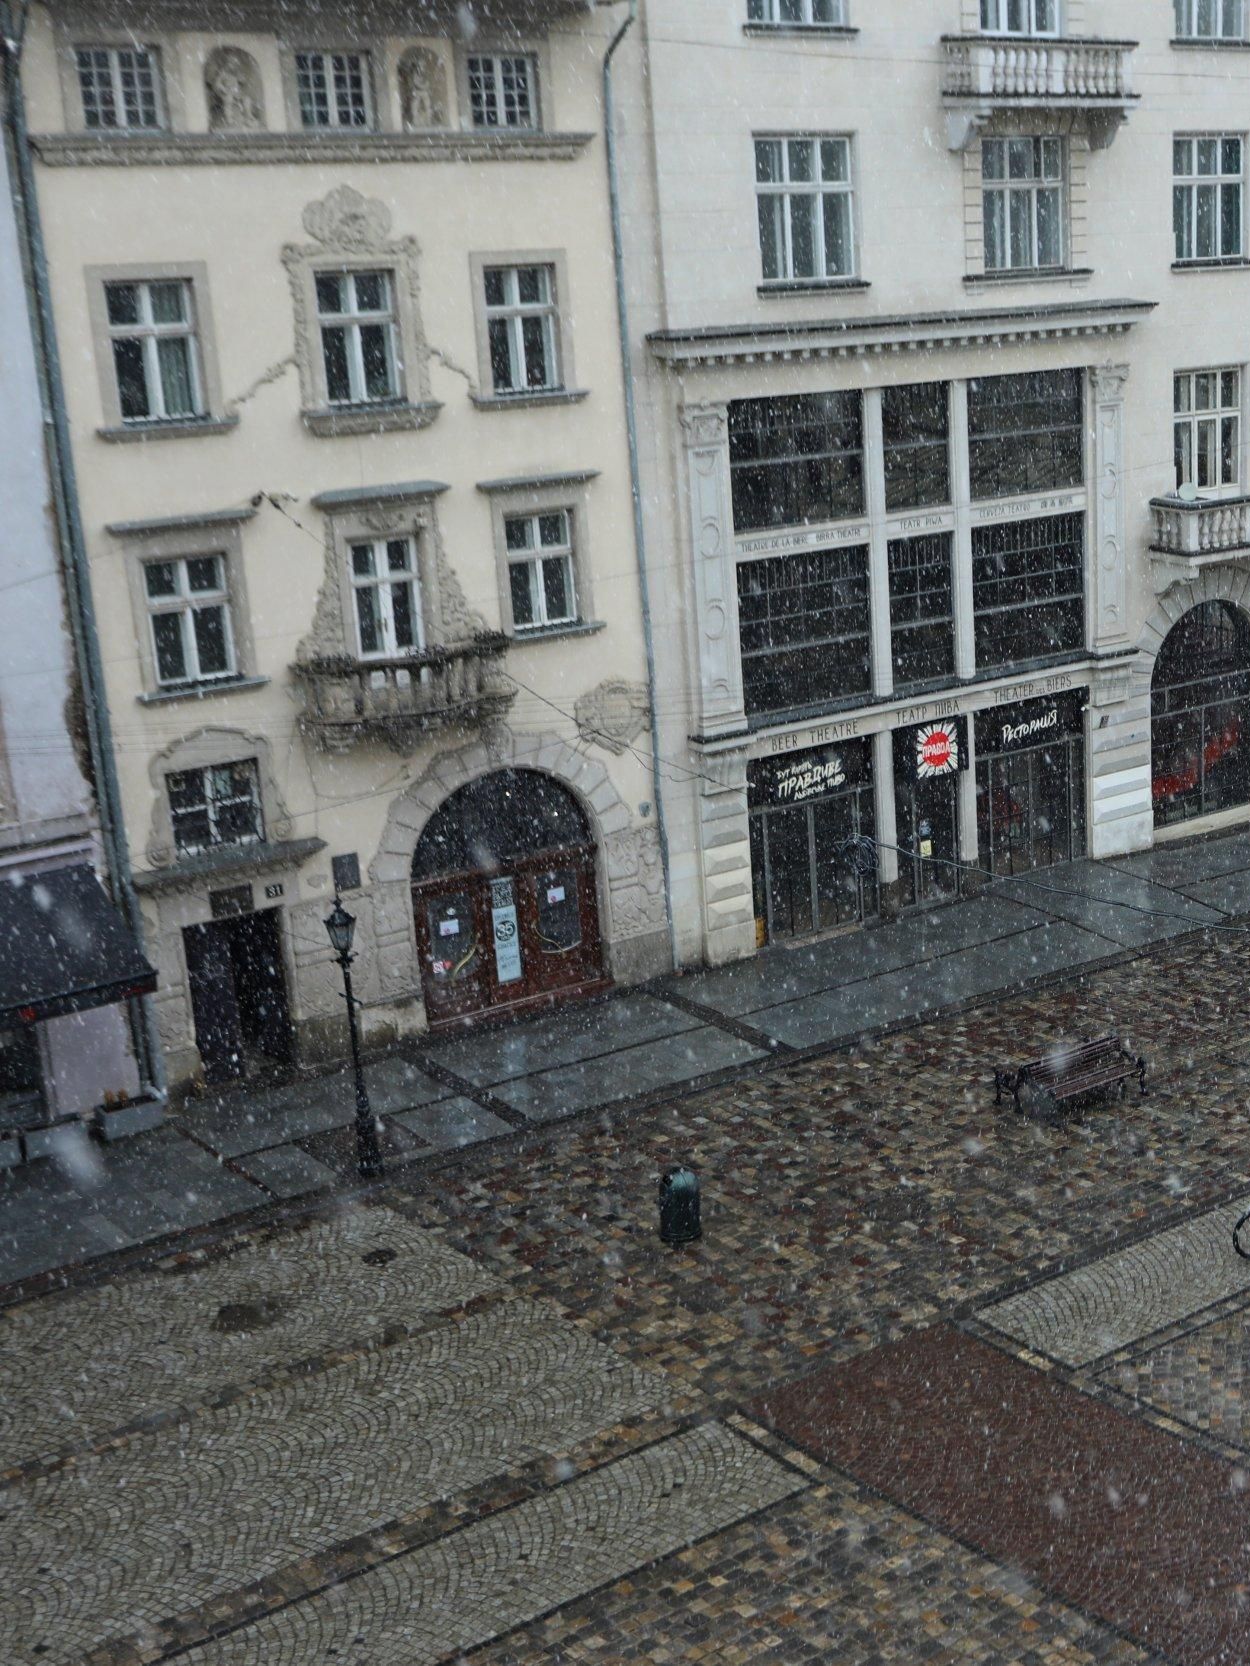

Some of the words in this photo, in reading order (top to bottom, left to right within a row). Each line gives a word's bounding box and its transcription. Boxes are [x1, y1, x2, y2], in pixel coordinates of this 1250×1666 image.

[900, 518, 921, 530] TEATR
[925, 515, 942, 526] PIWA
[994, 683, 1034, 703] THEATER
[1047, 674, 1072, 692] BIERS
[896, 707, 927, 725] ТЕАТР
[935, 700, 960, 718] ПИВА
[772, 733, 798, 752] BEER
[810, 720, 859, 744] THEATRE
[922, 741, 951, 758] ПРАВДА
[778, 759, 841, 798] ПРАВДИВЕ
[827, 773, 845, 788] ПИВО
